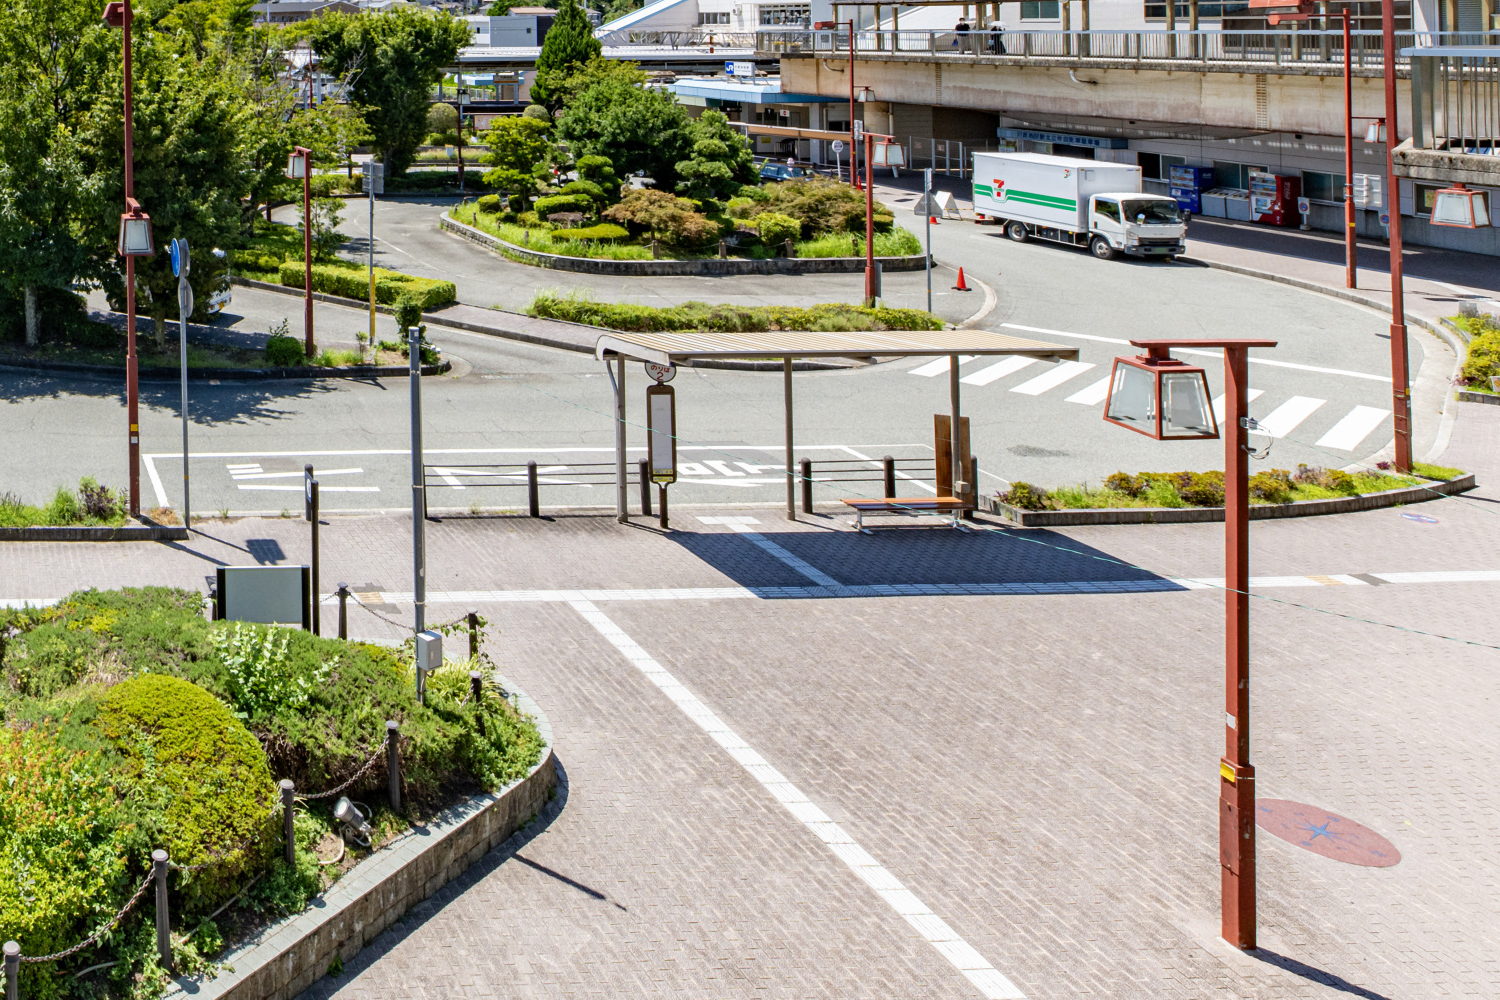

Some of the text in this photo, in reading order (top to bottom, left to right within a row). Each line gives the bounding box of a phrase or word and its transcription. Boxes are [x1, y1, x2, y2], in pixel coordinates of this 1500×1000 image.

[726, 64, 734, 72] JR
[650, 364, 670, 374] のりば
[657, 371, 664, 381] 2
